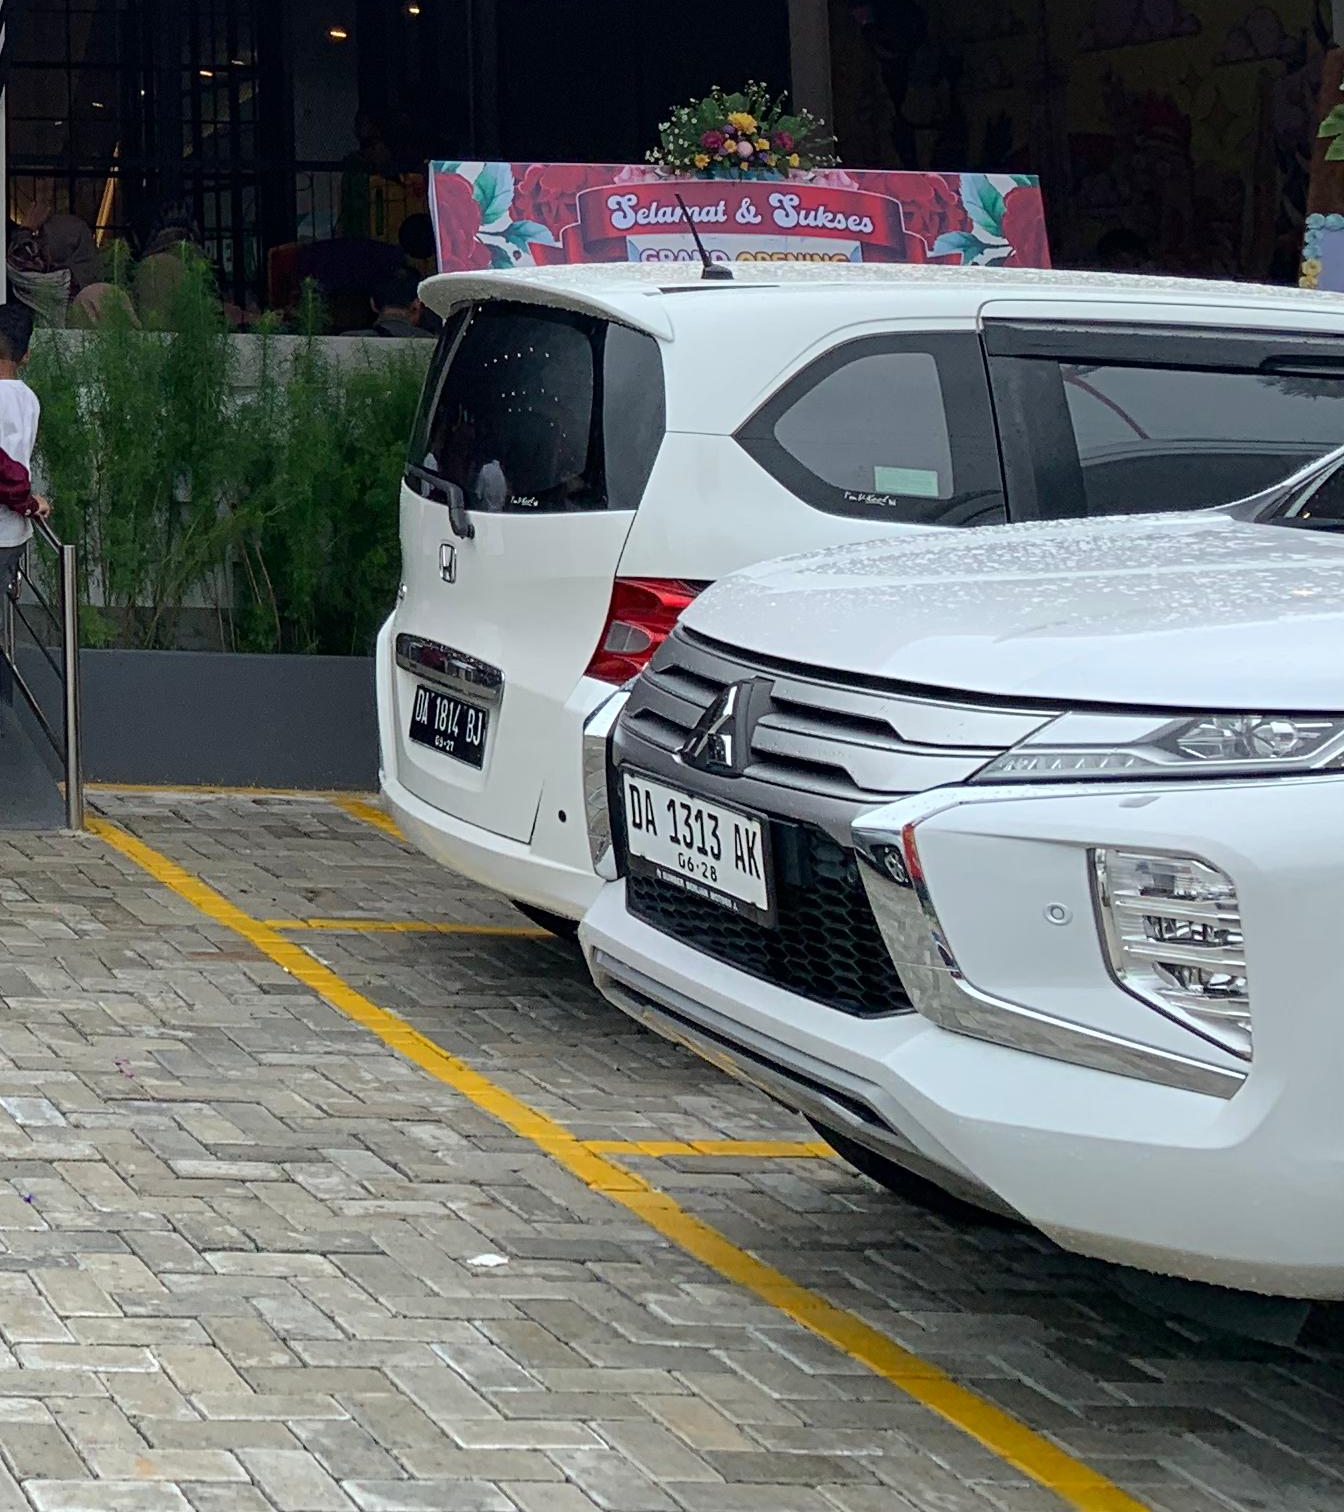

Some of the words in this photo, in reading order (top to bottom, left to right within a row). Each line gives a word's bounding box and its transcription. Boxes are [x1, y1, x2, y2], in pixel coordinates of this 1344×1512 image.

[606, 192, 728, 230] Selamat
[734, 196, 762, 225] &
[768, 192, 875, 234] Sukses
[415, 688, 428, 726] DA
[434, 696, 462, 738] 1814
[465, 707, 484, 747] BJ
[629, 783, 658, 837] DA
[666, 798, 722, 862] 1313
[734, 823, 761, 881] AK
